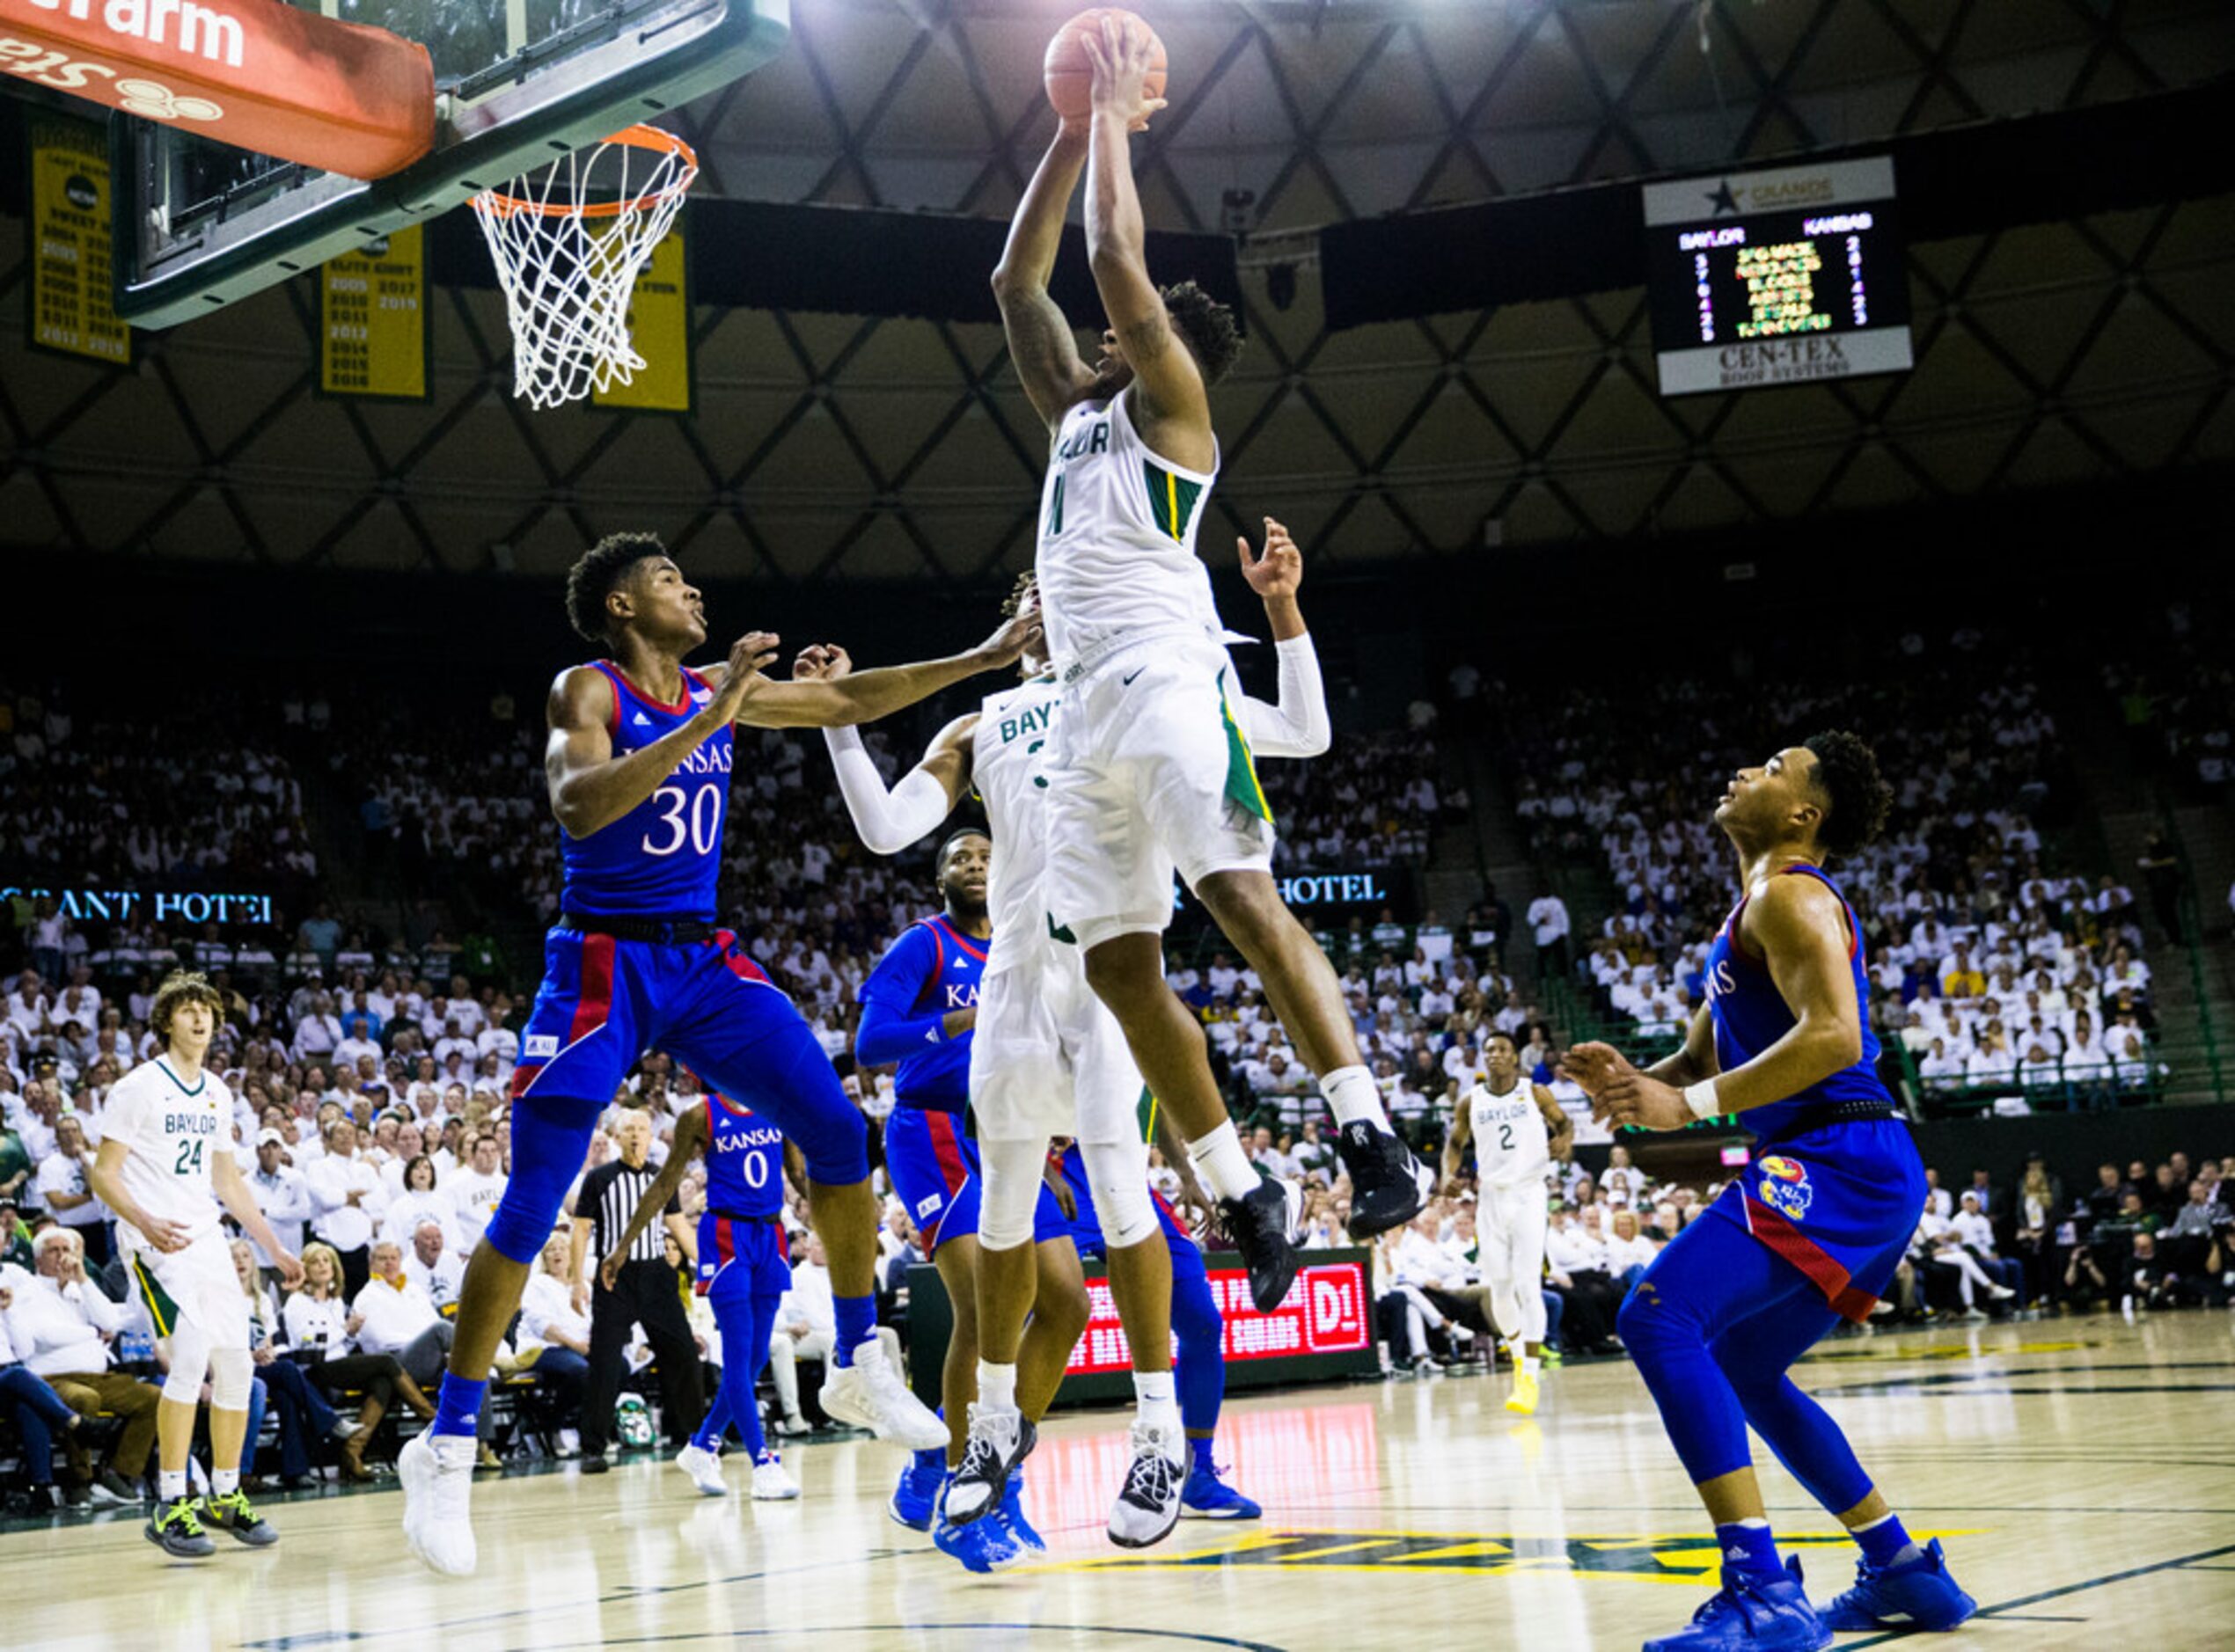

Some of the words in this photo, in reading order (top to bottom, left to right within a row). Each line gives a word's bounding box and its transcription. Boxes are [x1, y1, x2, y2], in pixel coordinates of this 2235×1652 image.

[70, 0, 244, 68] arm
[1679, 227, 1746, 251] BAYLOR
[1803, 212, 1873, 236] KANSAS
[1719, 338, 1843, 369] CEN-TEX
[1000, 700, 1054, 744] BAY
[642, 784, 722, 856] 30
[165, 1113, 216, 1135] BAYLOR
[1499, 1124, 1515, 1151] 2
[174, 1138, 203, 1175] 24
[744, 1150, 769, 1189] 0
